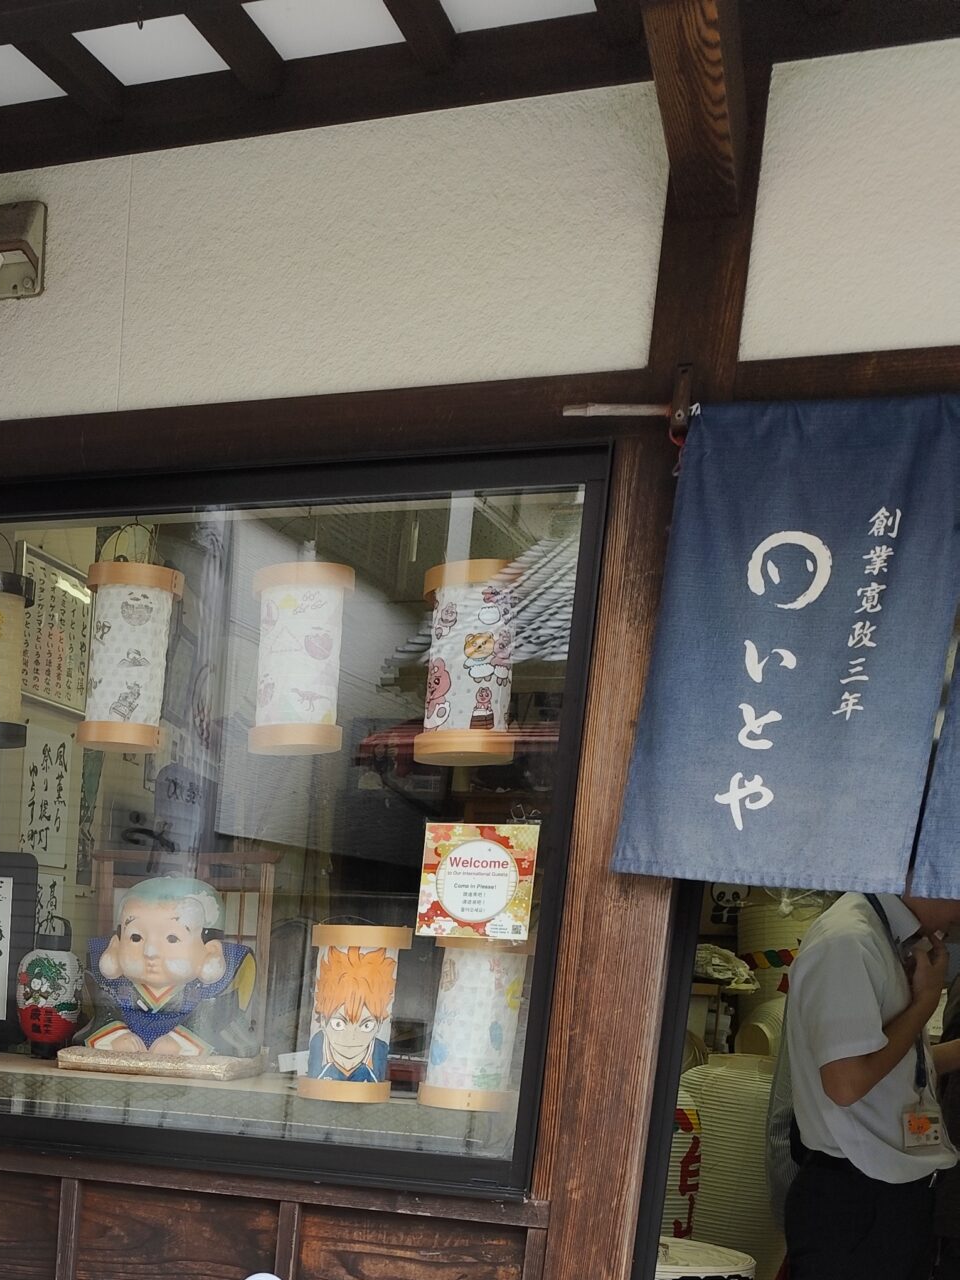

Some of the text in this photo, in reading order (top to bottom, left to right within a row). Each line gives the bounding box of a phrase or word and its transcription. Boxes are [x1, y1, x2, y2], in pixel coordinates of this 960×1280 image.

[831, 506, 902, 721] 創業寛政三年
[714, 639, 797, 832] いとや
[449, 856, 509, 869] Welcome
